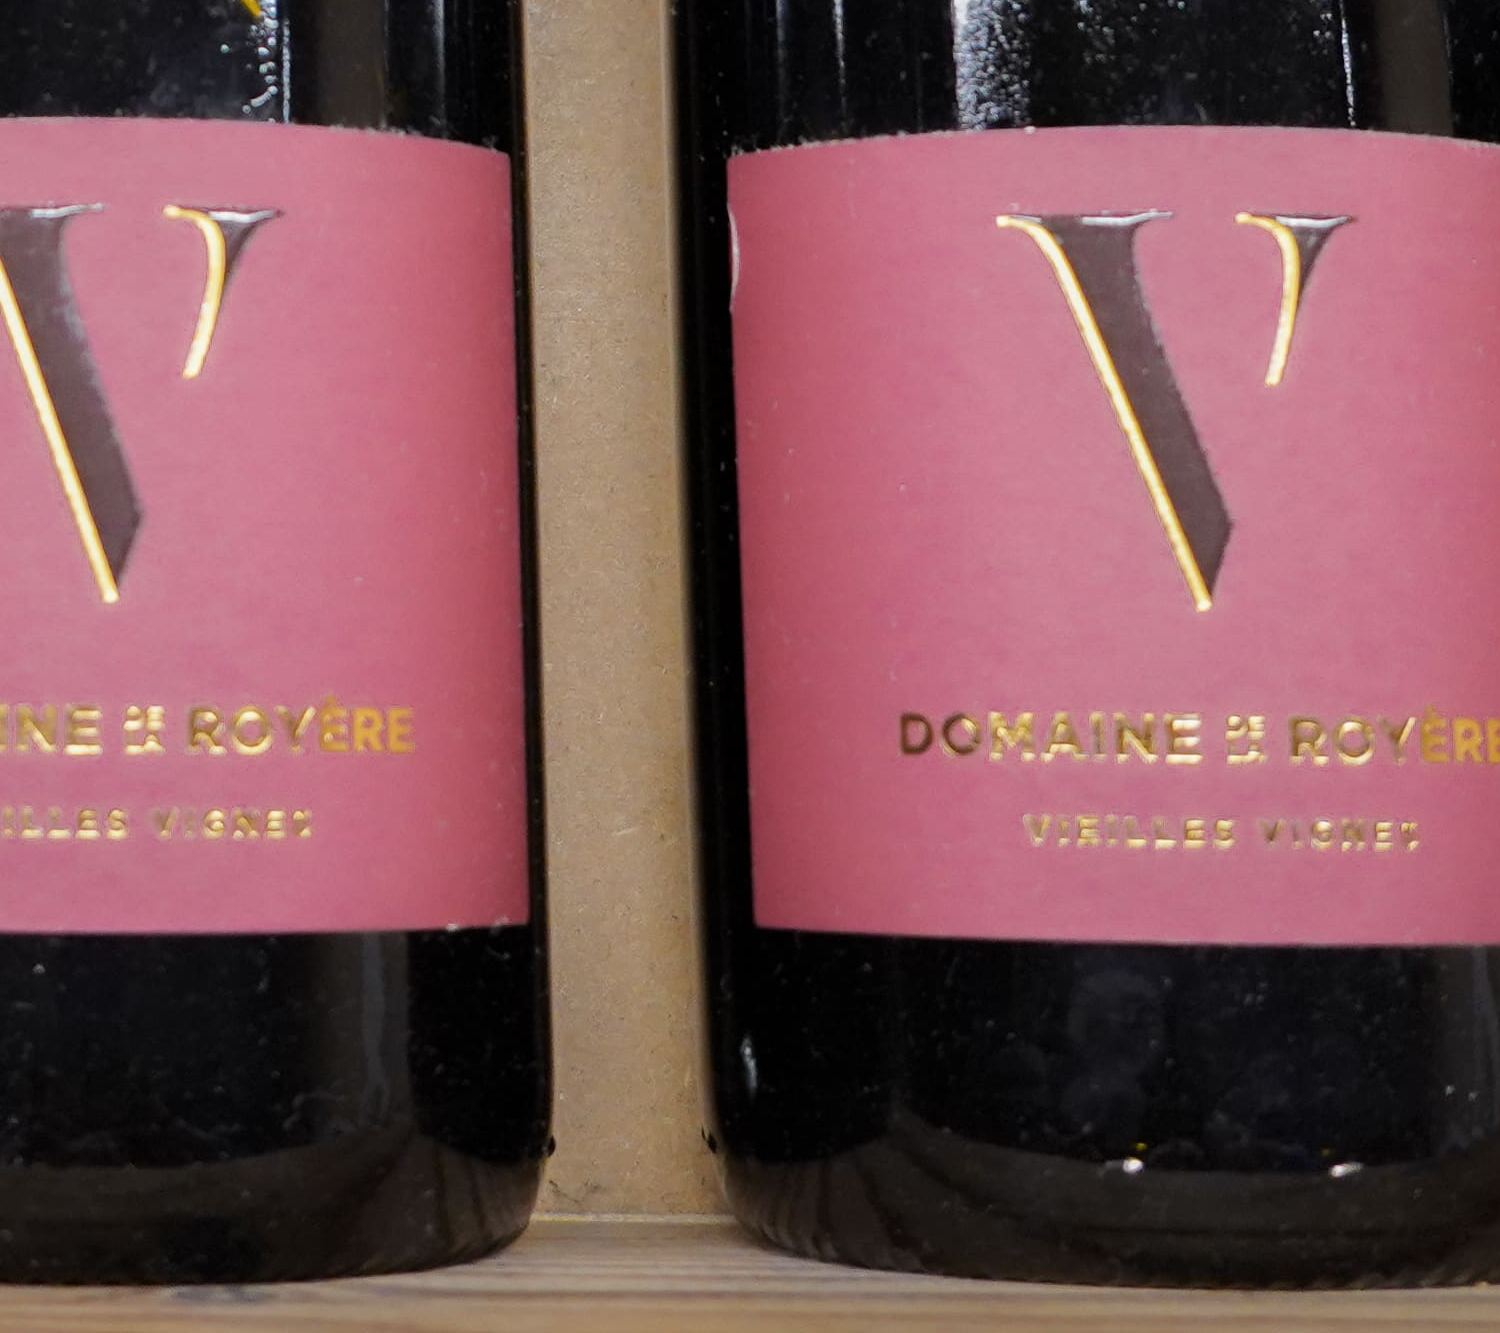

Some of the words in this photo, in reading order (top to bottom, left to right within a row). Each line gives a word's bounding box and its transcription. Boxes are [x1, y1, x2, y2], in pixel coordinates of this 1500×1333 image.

[994, 209, 1360, 614] V
[185, 695, 415, 756] ROYÈRE
[899, 711, 1203, 765] DOMAINE
[1022, 813, 1237, 849] VIEILLES
